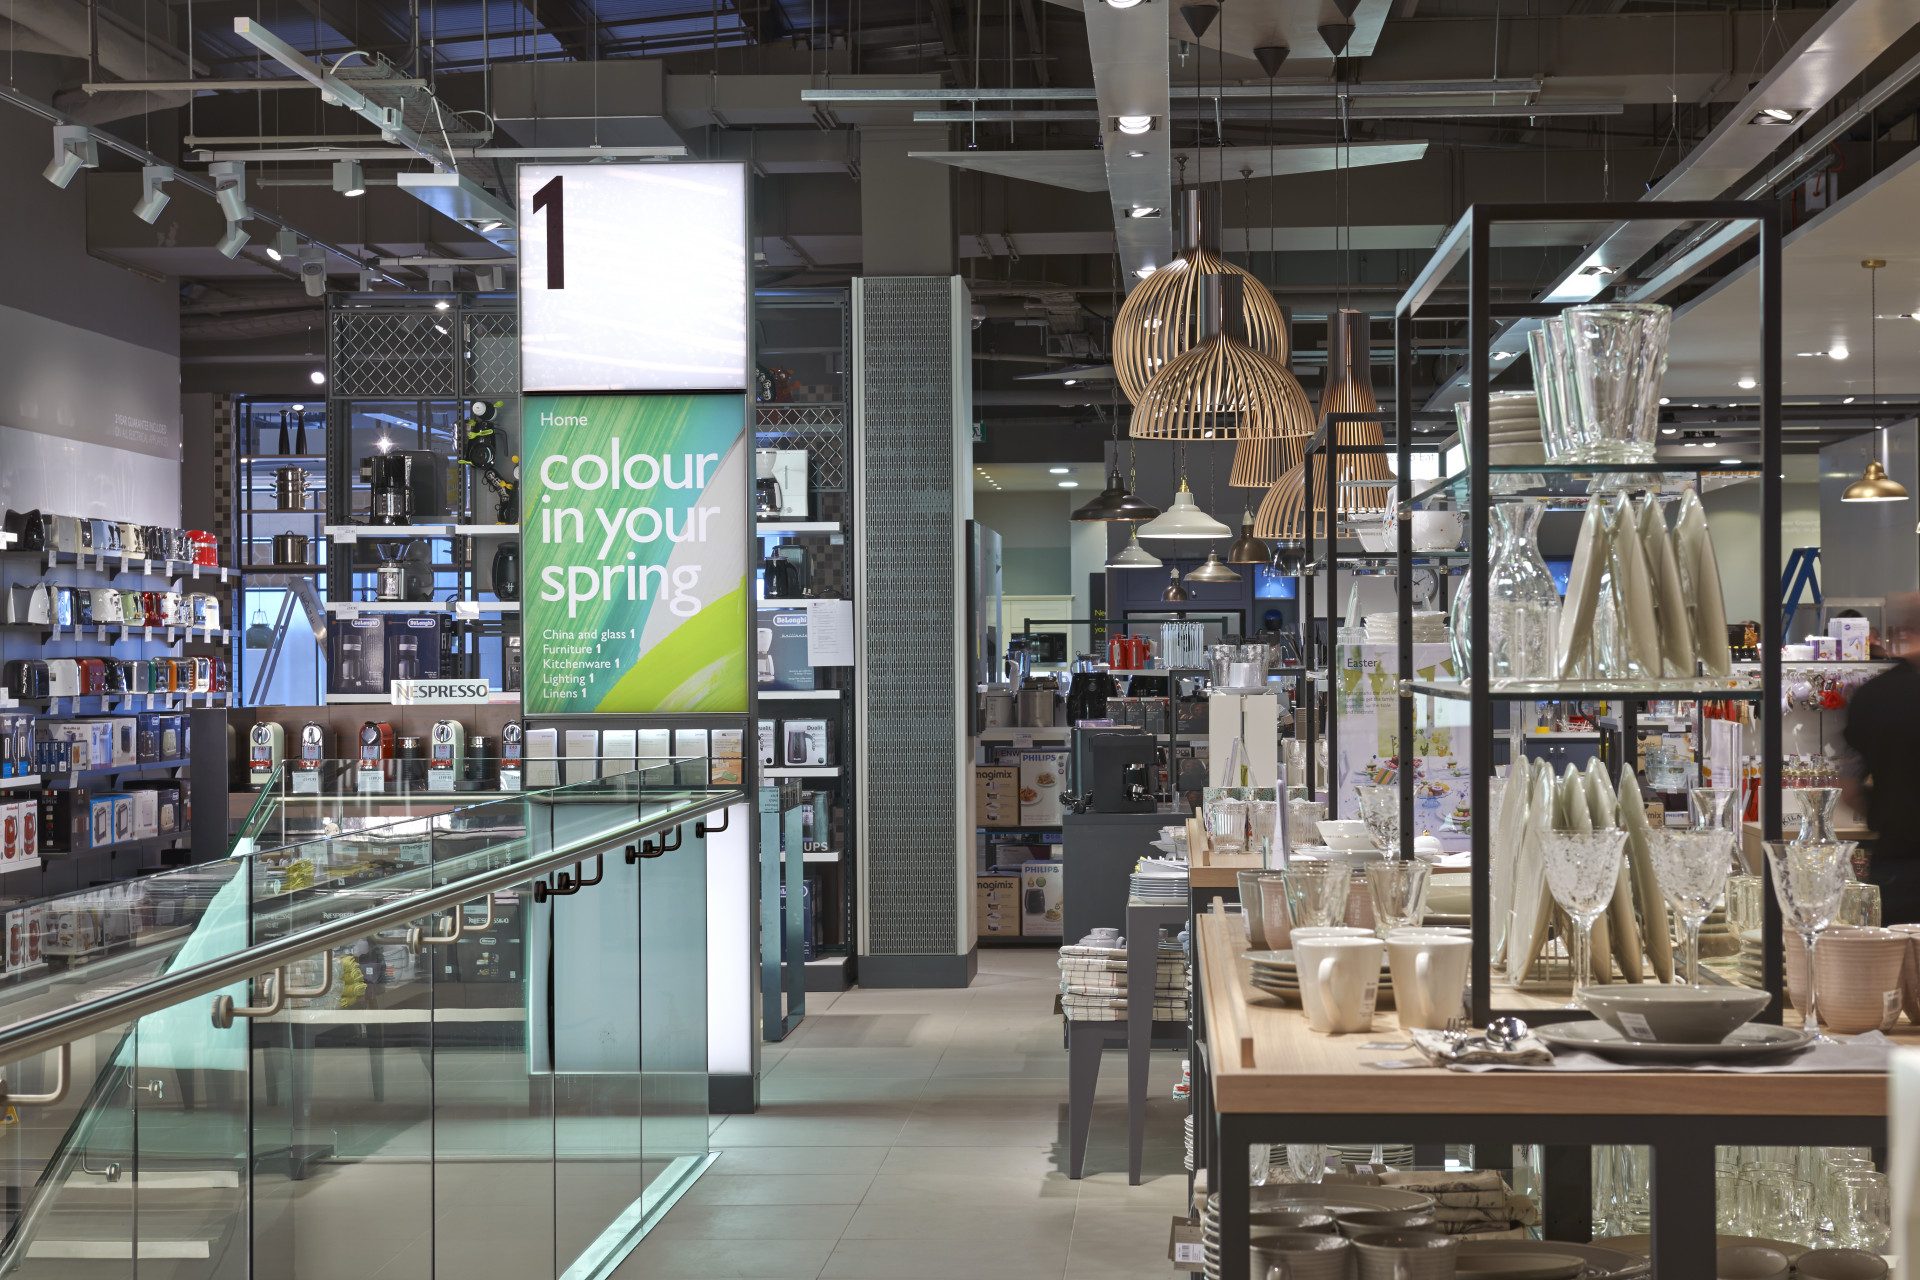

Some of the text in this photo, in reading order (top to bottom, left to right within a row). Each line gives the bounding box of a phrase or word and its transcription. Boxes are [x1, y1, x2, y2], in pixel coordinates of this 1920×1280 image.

[532, 175, 565, 290] 1
[540, 411, 588, 427] Home
[540, 437, 718, 490] colour
[541, 494, 721, 561] in your
[540, 551, 702, 618] spring
[542, 628, 636, 643] China and glass 1
[542, 643, 602, 655] Furniture 1
[542, 658, 620, 670] Kitchenware 1
[1346, 658, 1378, 668] Easter
[542, 672, 595, 686] Lighting 1
[395, 682, 488, 701] NESPRESSO
[542, 687, 588, 699] Linens 1
[996, 749, 1020, 757] KENW
[1022, 754, 1057, 762] PHILIPS
[1024, 866, 1060, 874] PHILIPS
